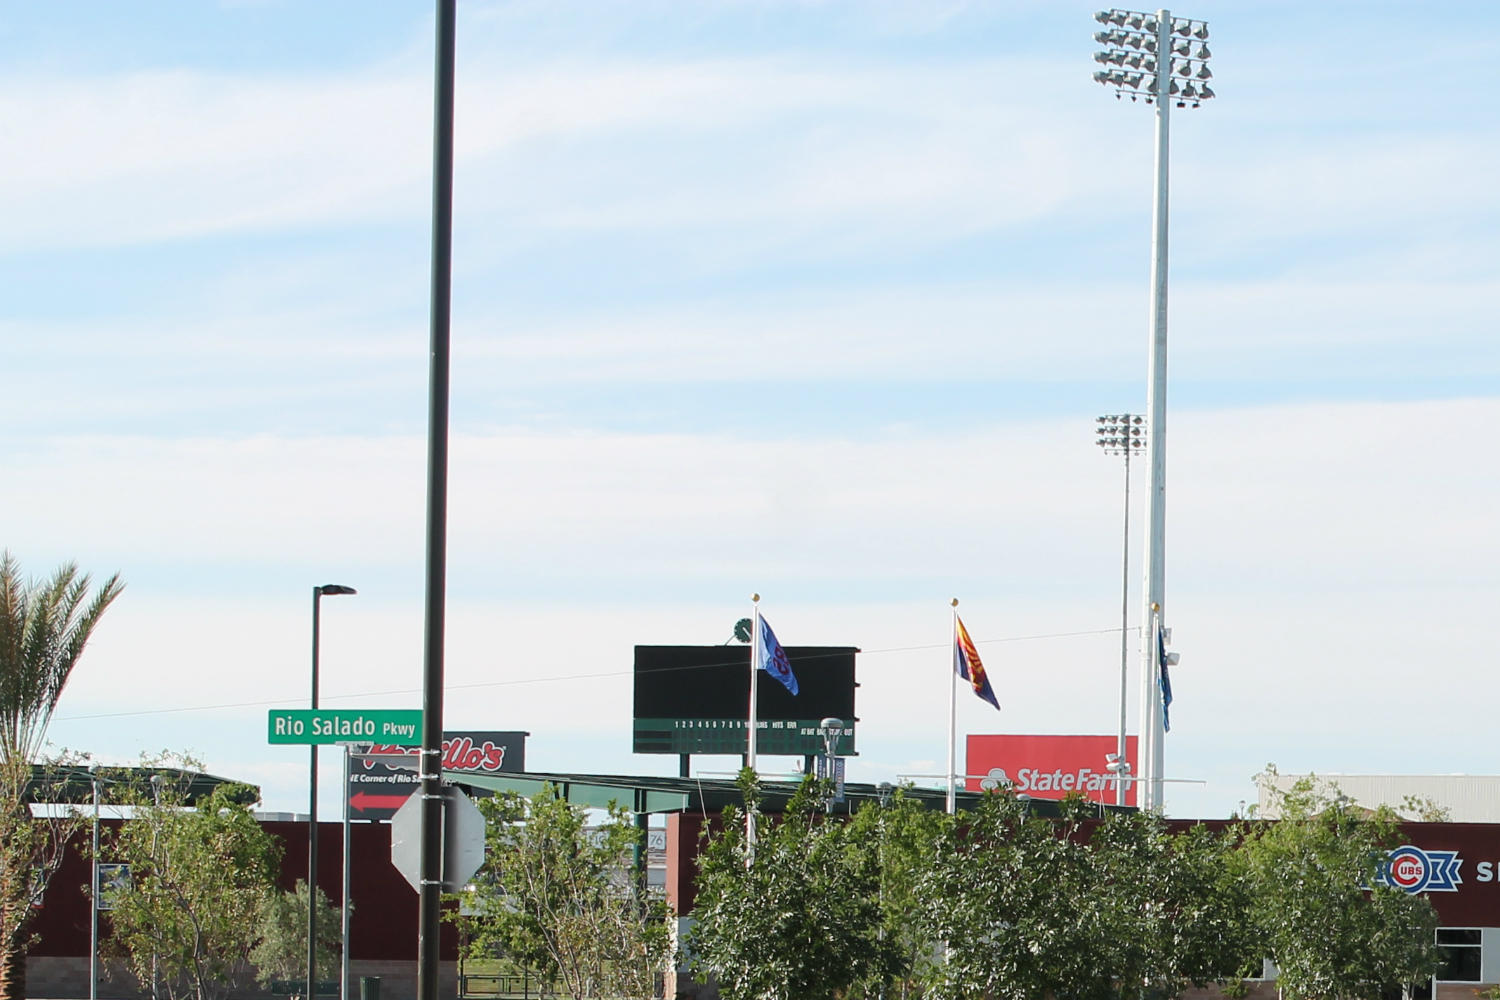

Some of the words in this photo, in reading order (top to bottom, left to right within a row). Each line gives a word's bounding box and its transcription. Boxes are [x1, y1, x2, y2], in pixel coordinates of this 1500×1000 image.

[275, 716, 304, 735] Rio
[312, 716, 376, 736] Salado
[383, 722, 416, 738] Pkwy
[360, 774, 387, 783] Corner
[388, 774, 398, 784] of
[398, 774, 412, 783] Rio
[1392, 855, 1423, 886] CUBS
